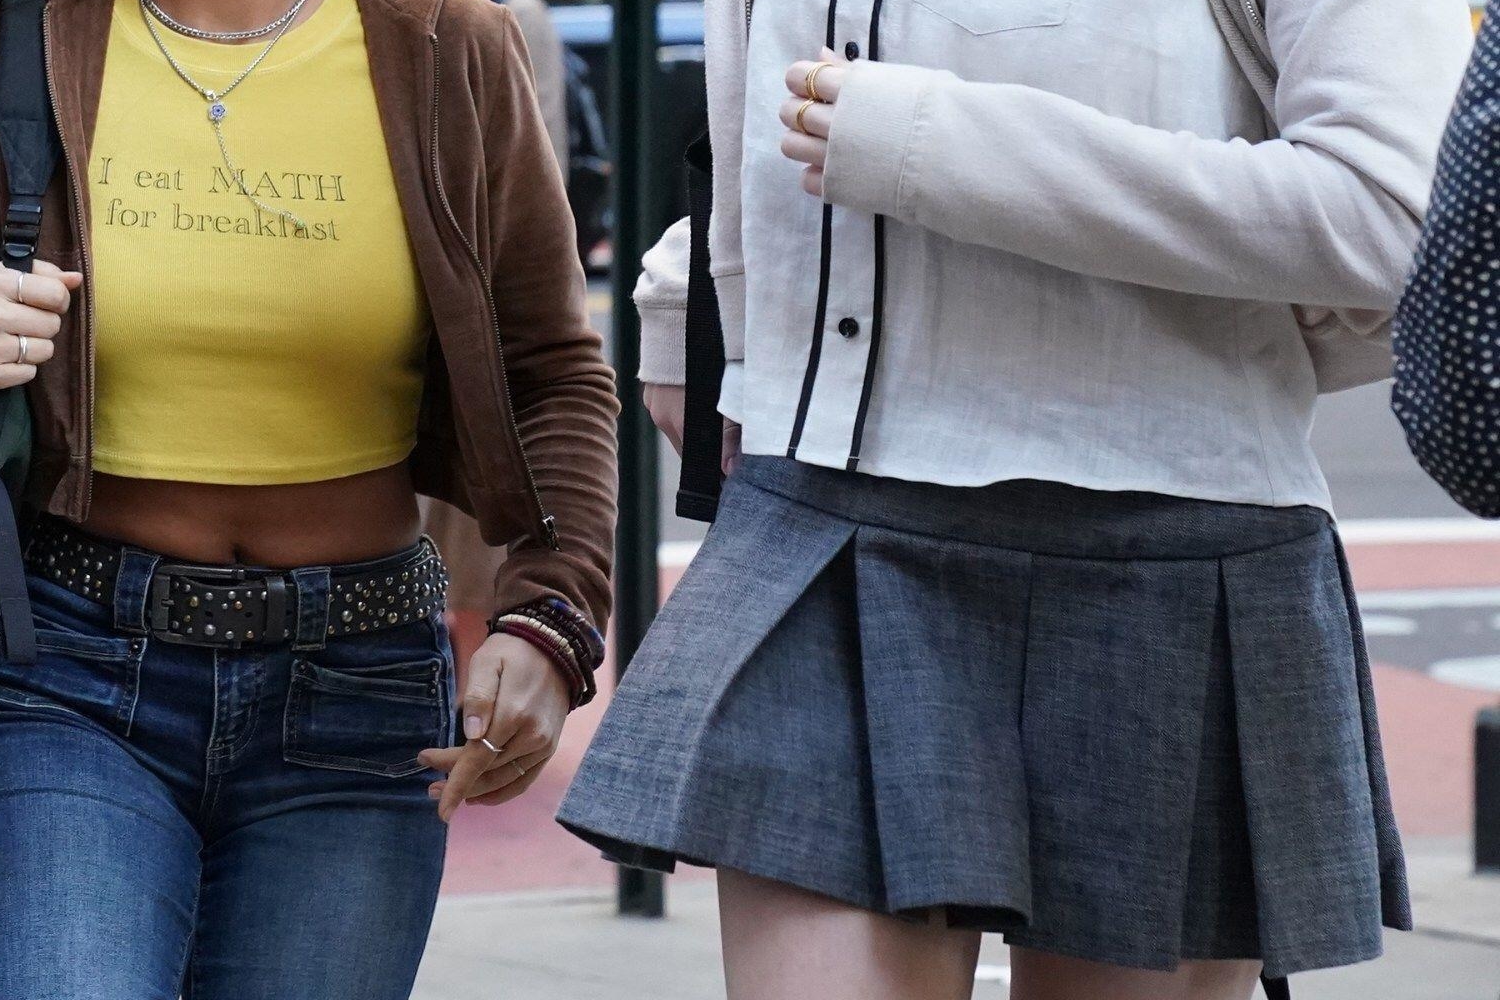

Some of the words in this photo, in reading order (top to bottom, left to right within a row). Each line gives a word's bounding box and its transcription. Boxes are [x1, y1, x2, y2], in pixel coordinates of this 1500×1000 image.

[98, 157, 112, 185] I
[134, 169, 184, 191] eat
[208, 166, 346, 202] MATH
[105, 198, 157, 228] for
[172, 202, 340, 241] breakfast
